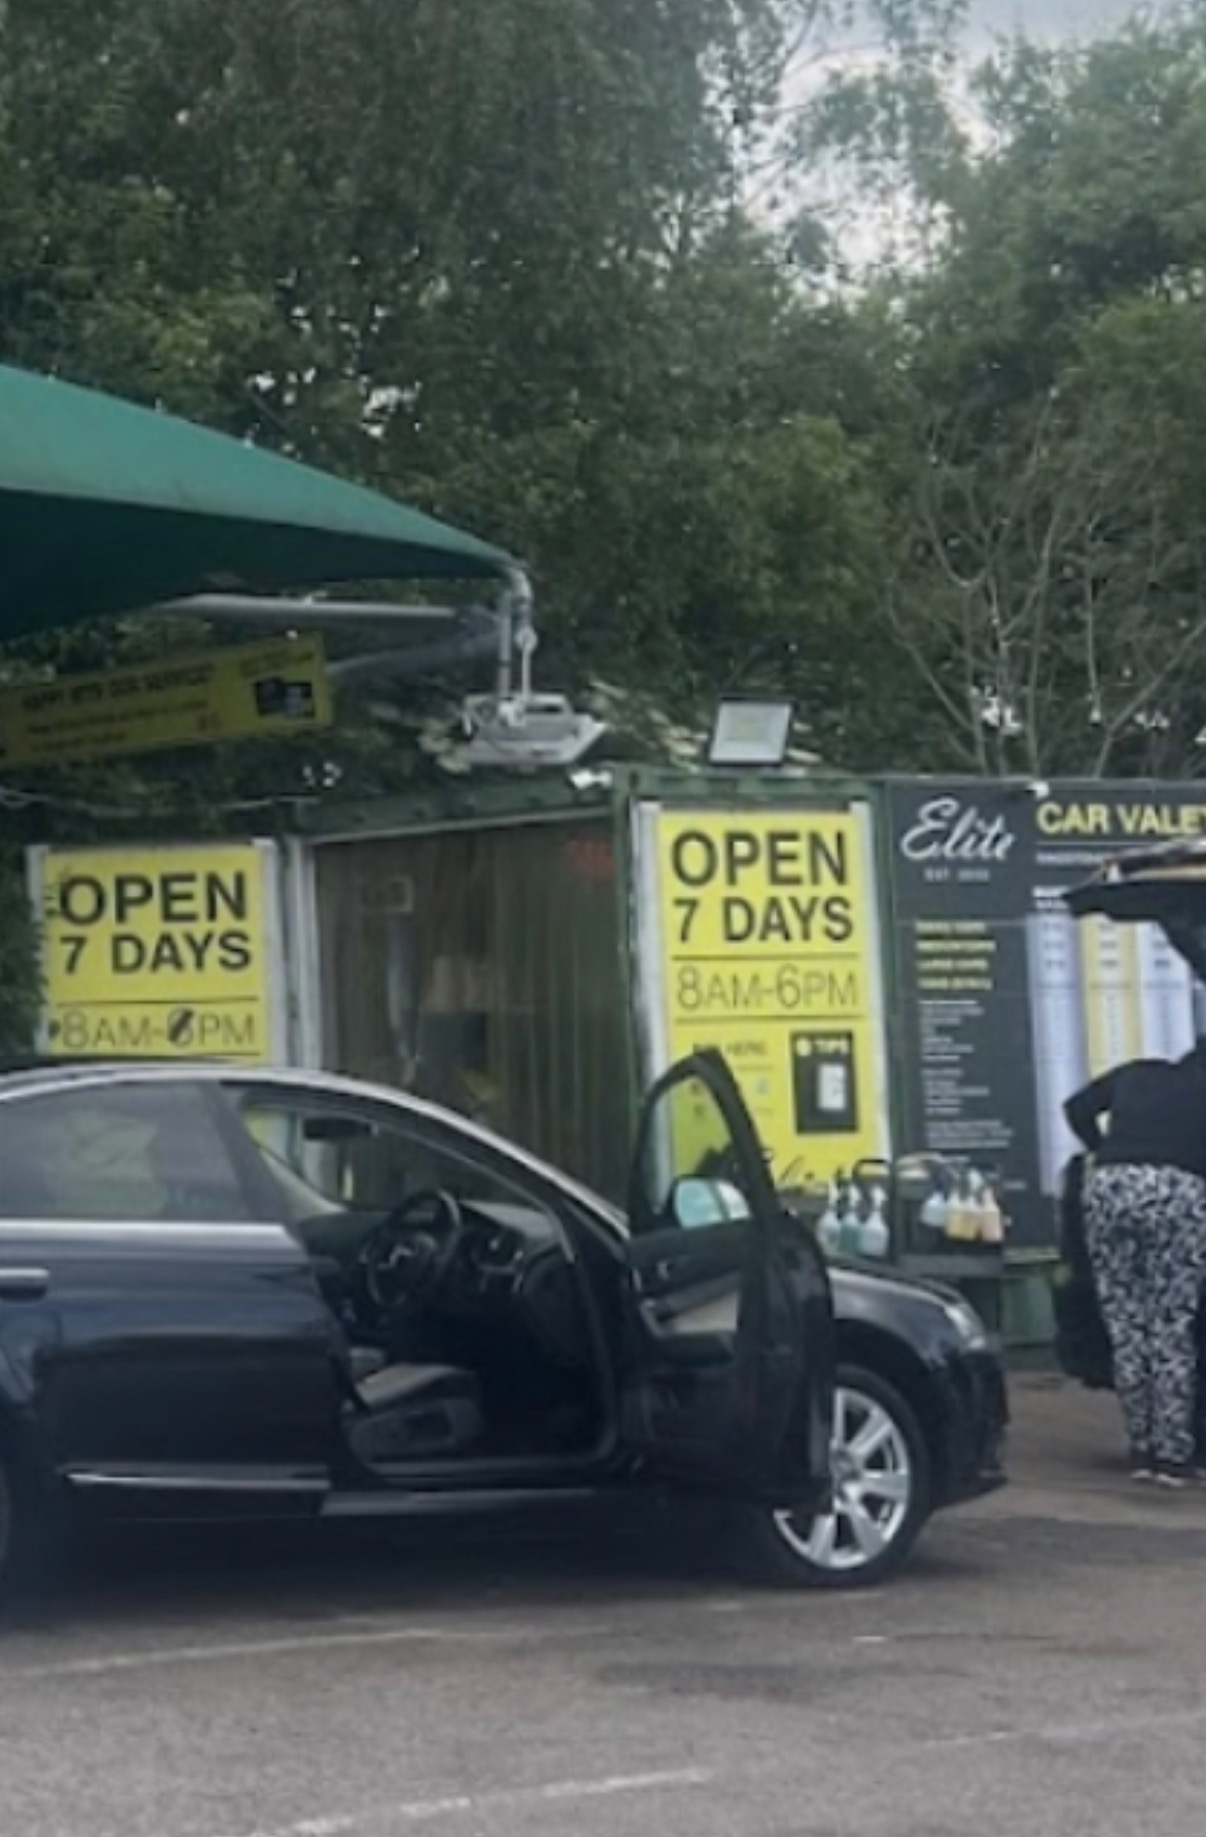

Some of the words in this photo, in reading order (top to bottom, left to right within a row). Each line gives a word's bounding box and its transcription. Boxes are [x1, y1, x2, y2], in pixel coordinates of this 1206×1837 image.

[900, 796, 1015, 861] Elite
[1036, 803, 1109, 834] CAR
[671, 829, 848, 887] OPEN
[59, 870, 247, 926] OPEN
[672, 897, 699, 942] 7
[723, 896, 853, 941] DAYS
[60, 935, 87, 975] 7
[111, 930, 251, 975] DAYS
[677, 963, 858, 1010] 8AM-6PM
